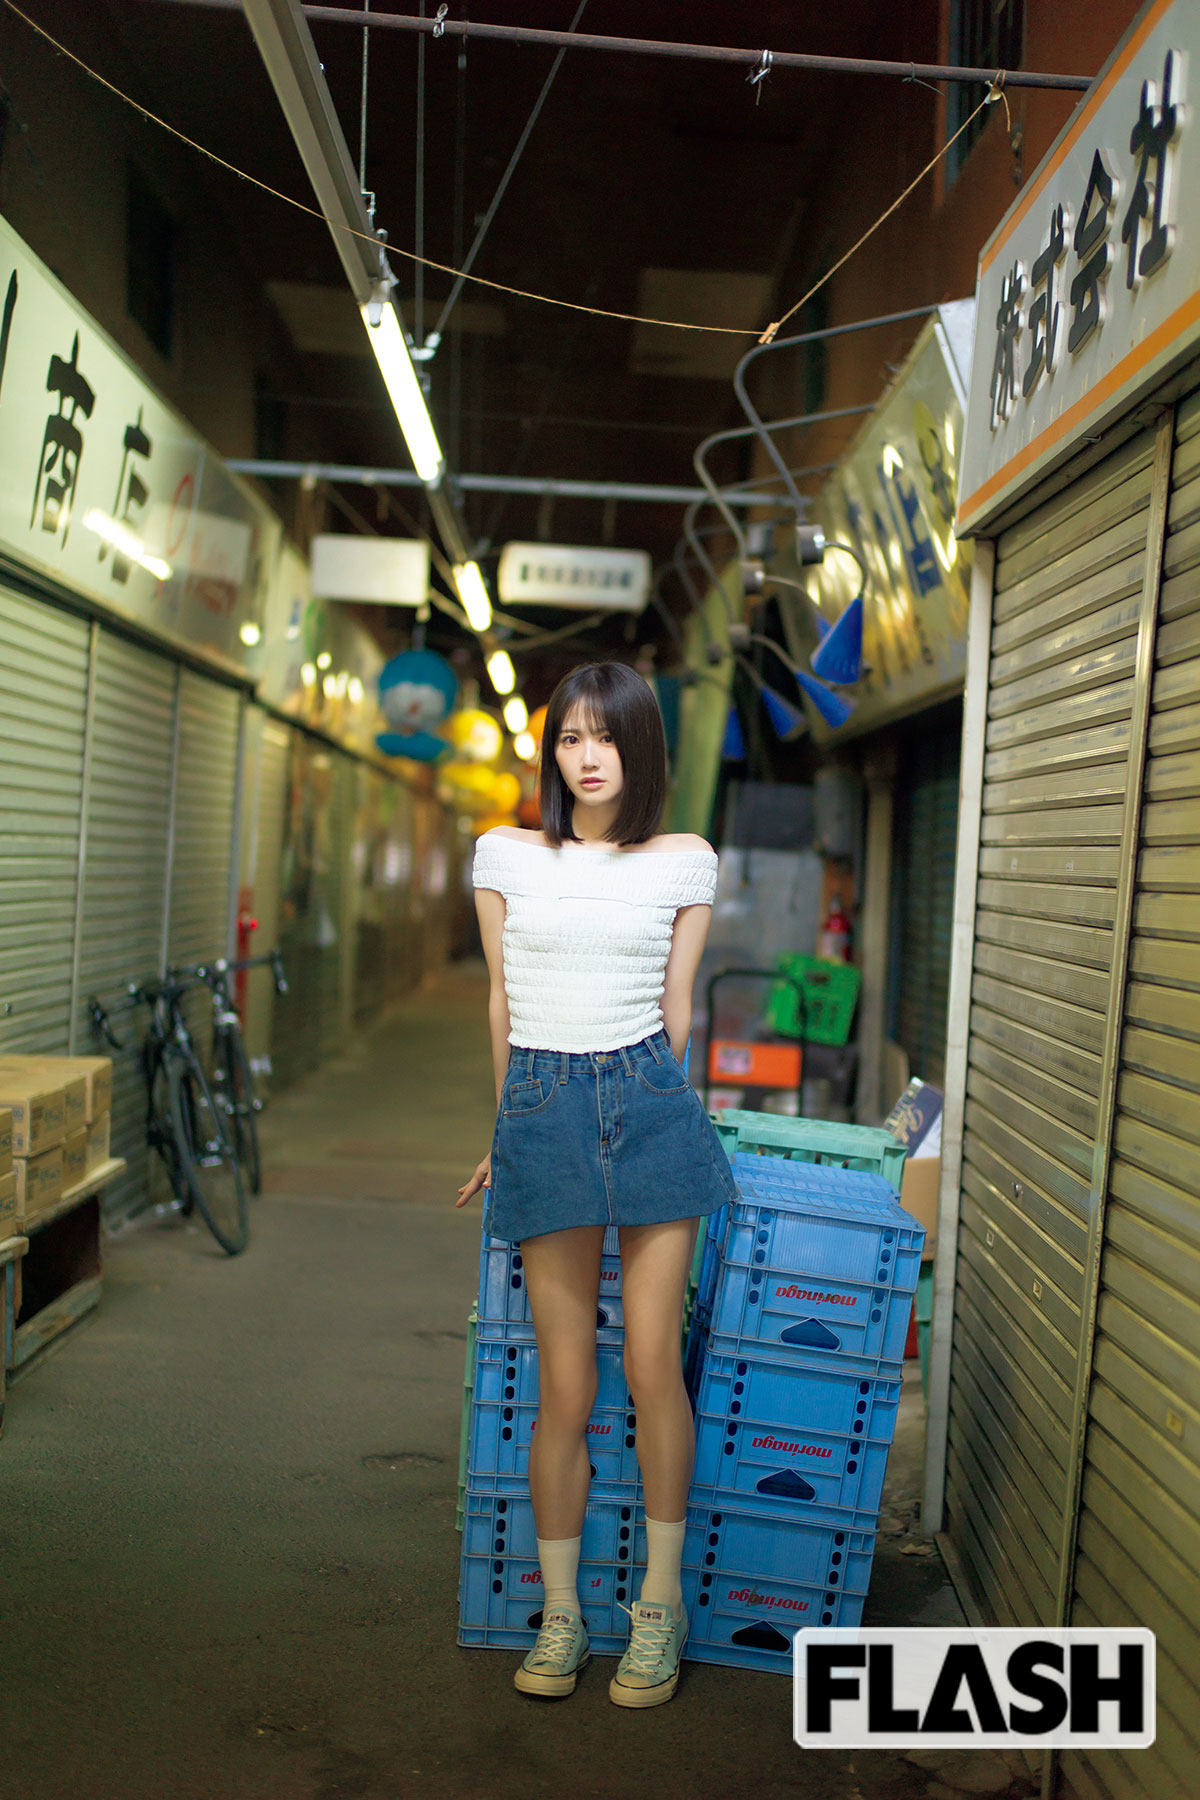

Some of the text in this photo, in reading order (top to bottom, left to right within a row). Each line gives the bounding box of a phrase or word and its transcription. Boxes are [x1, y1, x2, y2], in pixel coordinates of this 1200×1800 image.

[989, 48, 1184, 432] 株式会社
[775, 1284, 857, 1307] morinaga
[752, 1435, 833, 1459] morinaga
